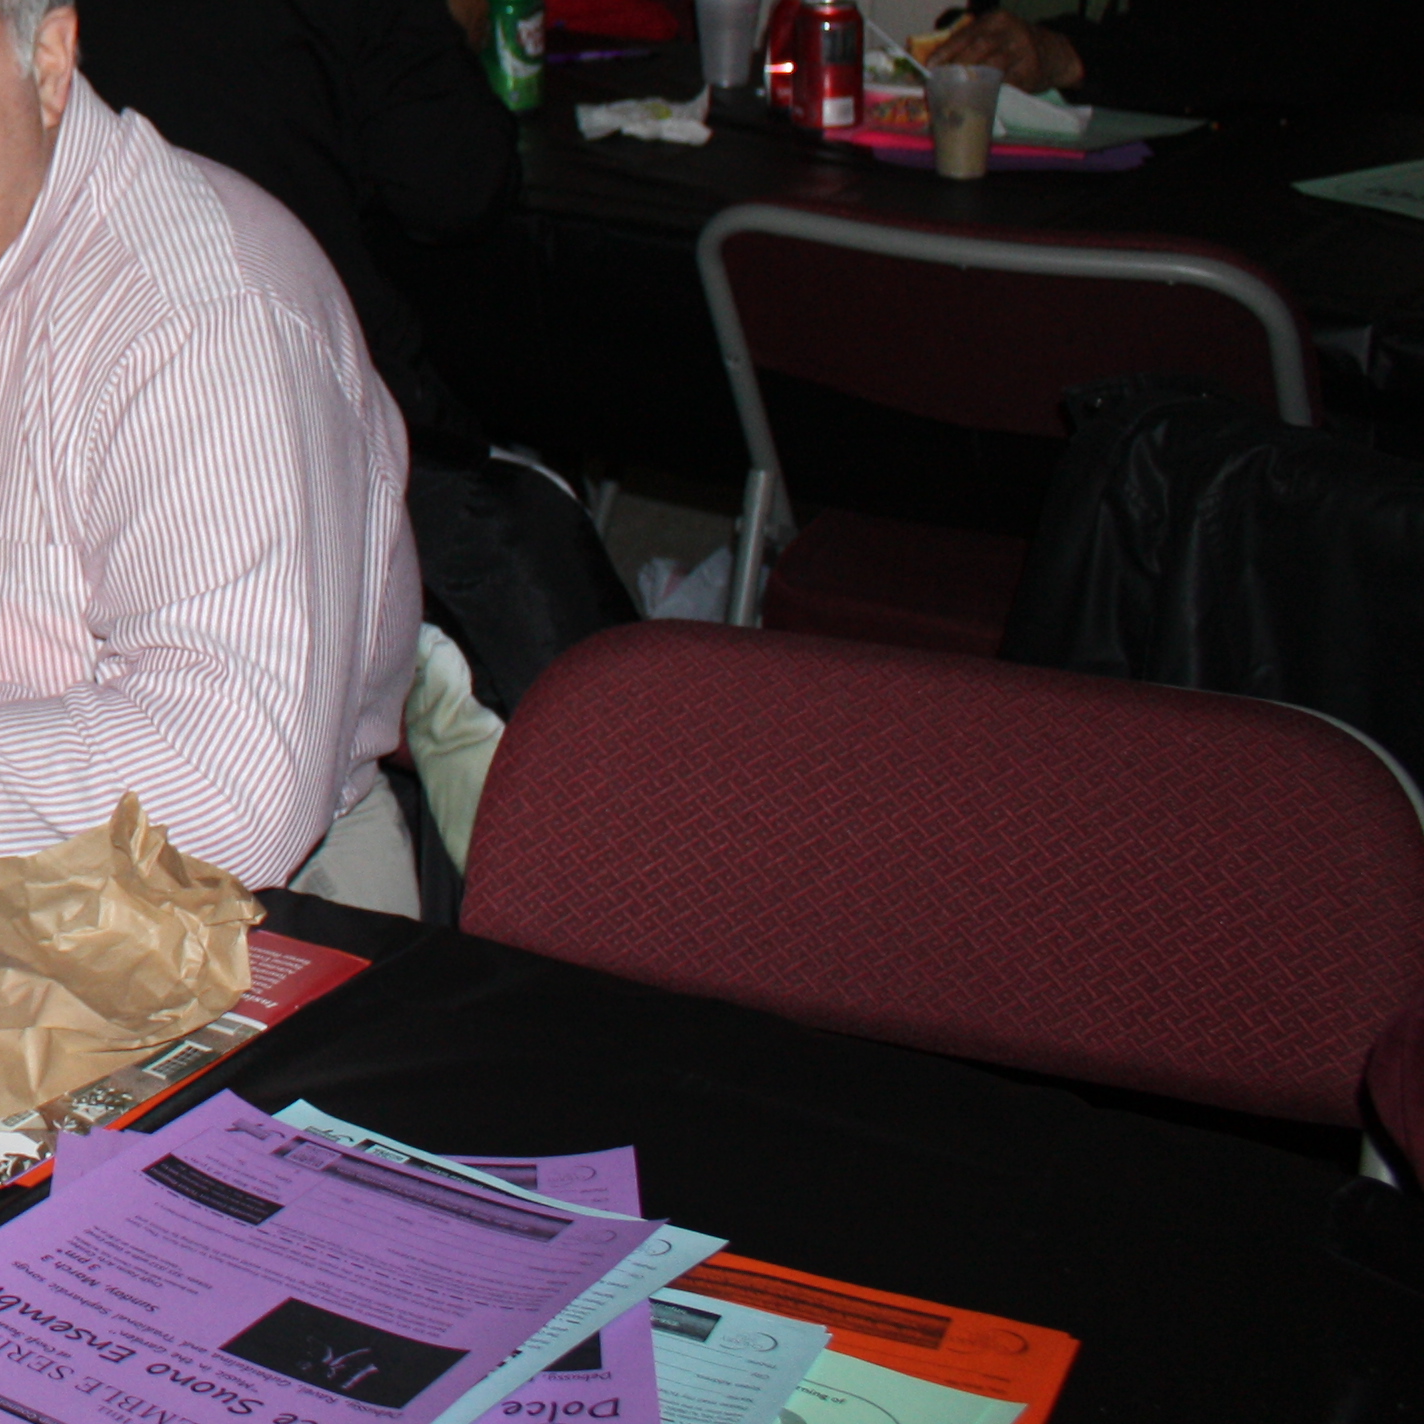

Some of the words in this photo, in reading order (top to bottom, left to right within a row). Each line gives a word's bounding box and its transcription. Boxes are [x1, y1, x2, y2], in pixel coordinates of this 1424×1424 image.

[54, 1261, 101, 1287] March
[104, 1284, 160, 1313] Sunday,
[170, 1352, 193, 1366] the
[74, 1375, 197, 1424] MBLE
[146, 1363, 265, 1416] Suono
[501, 1397, 620, 1423] Dolce
